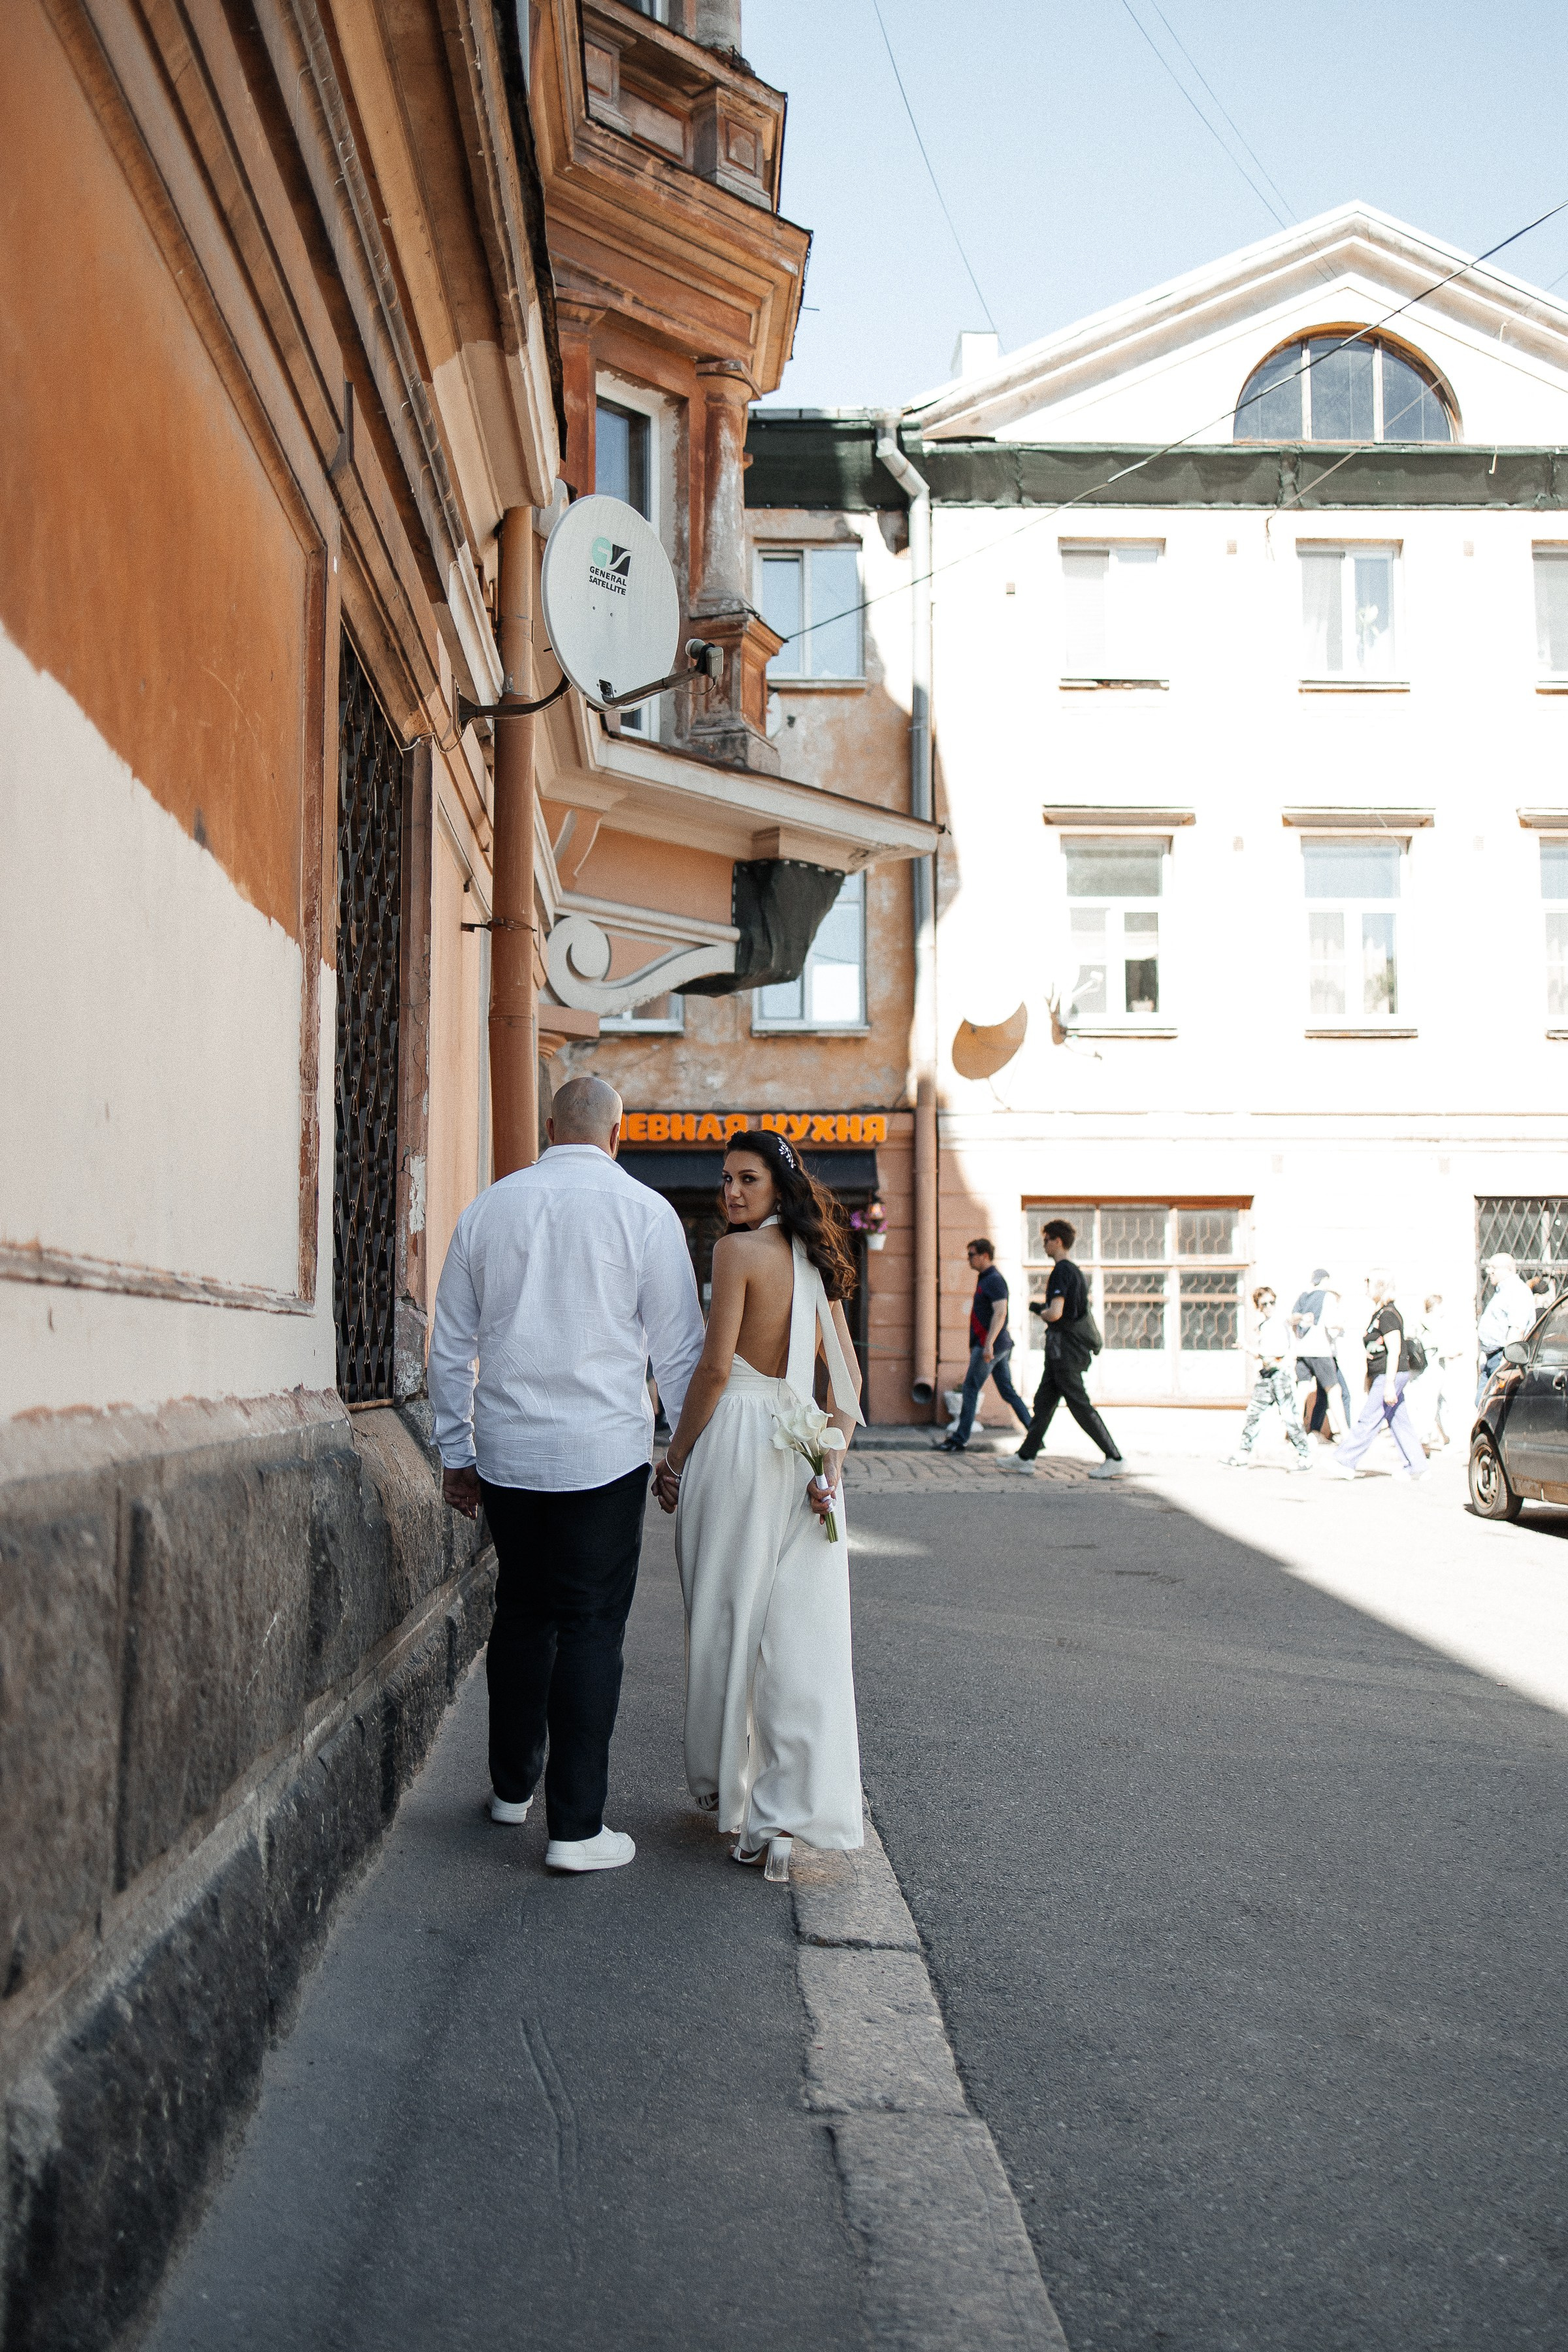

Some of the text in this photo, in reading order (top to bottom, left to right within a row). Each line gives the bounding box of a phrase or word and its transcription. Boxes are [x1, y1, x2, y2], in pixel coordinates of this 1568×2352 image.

[589, 576, 627, 595] SATELLITE
[590, 566, 627, 586] GENERAL
[762, 1113, 886, 1142] КУХНЯ
